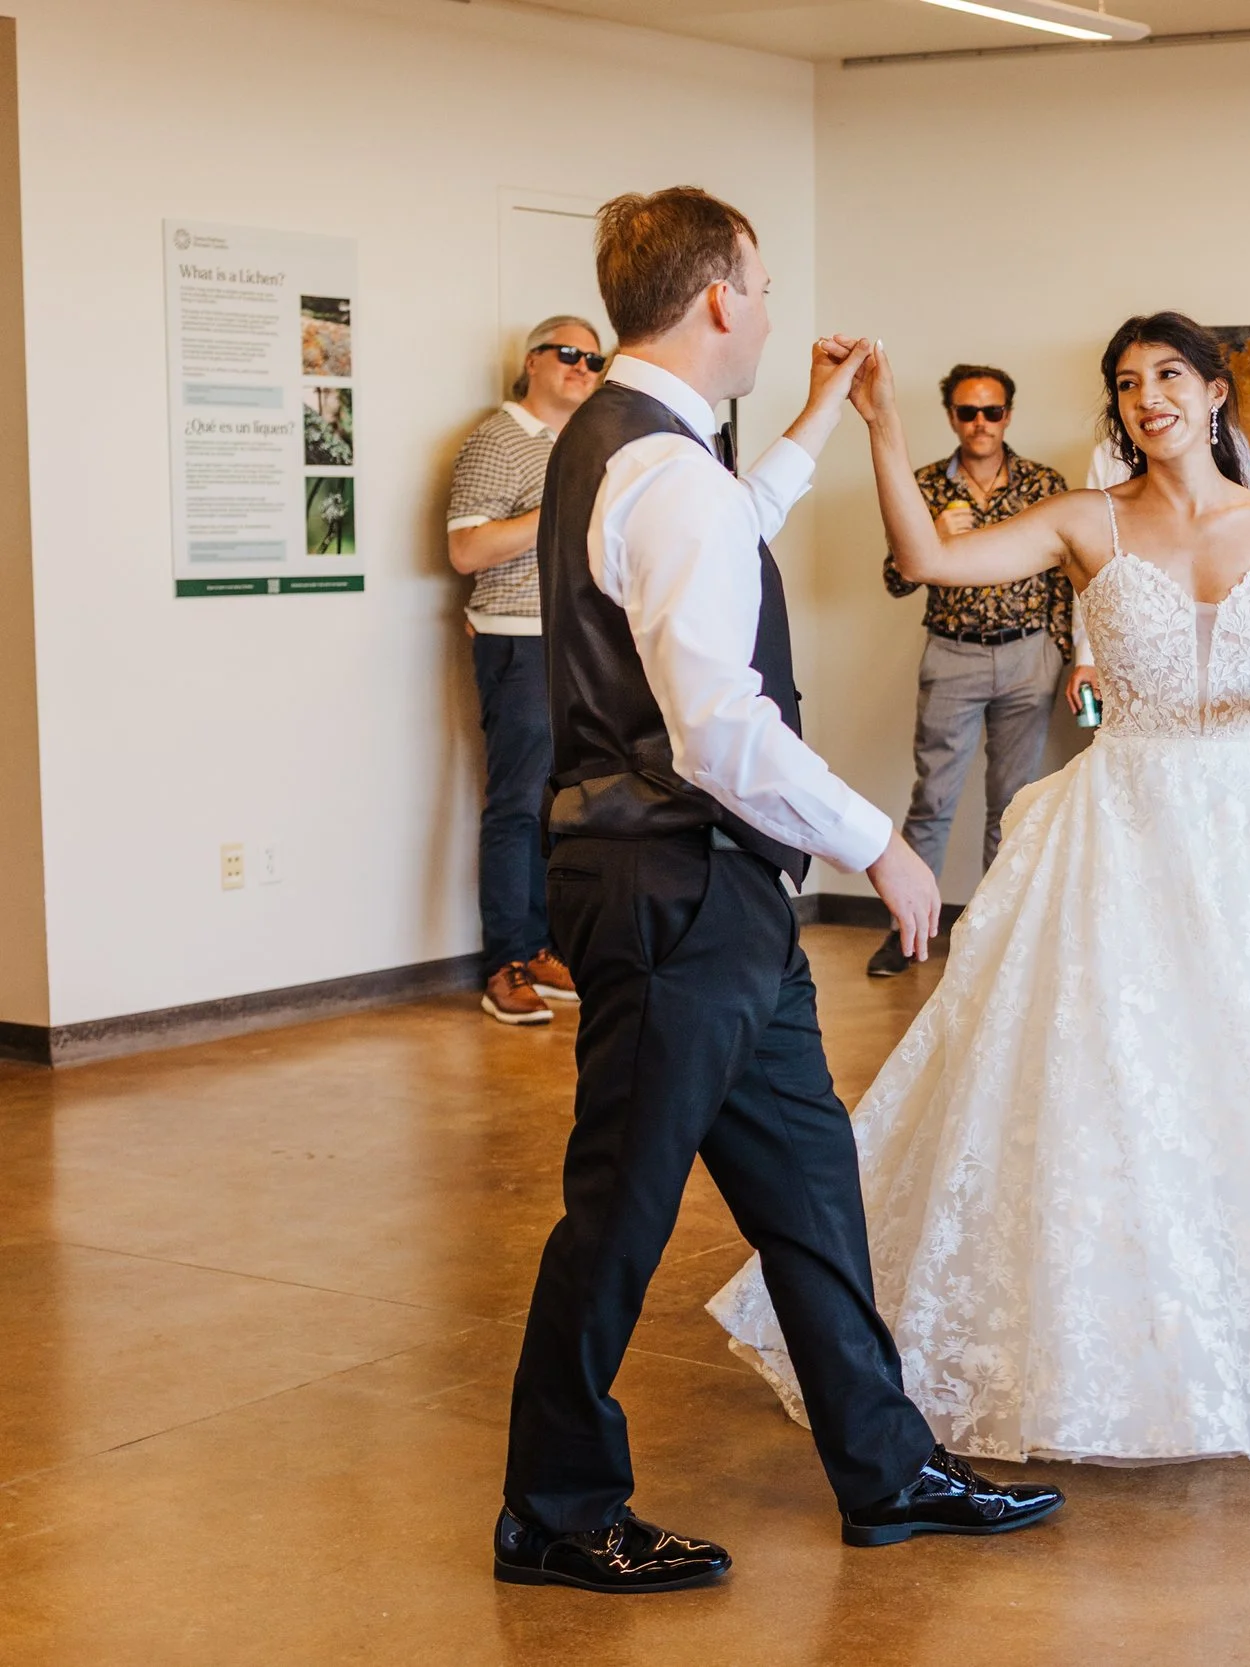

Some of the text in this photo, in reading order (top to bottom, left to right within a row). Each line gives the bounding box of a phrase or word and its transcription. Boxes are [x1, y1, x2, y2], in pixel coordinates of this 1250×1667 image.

[178, 264, 286, 286] What is a Lichen?
[185, 417, 216, 436] ¿Qué
[219, 423, 233, 433] es
[235, 422, 250, 433] un
